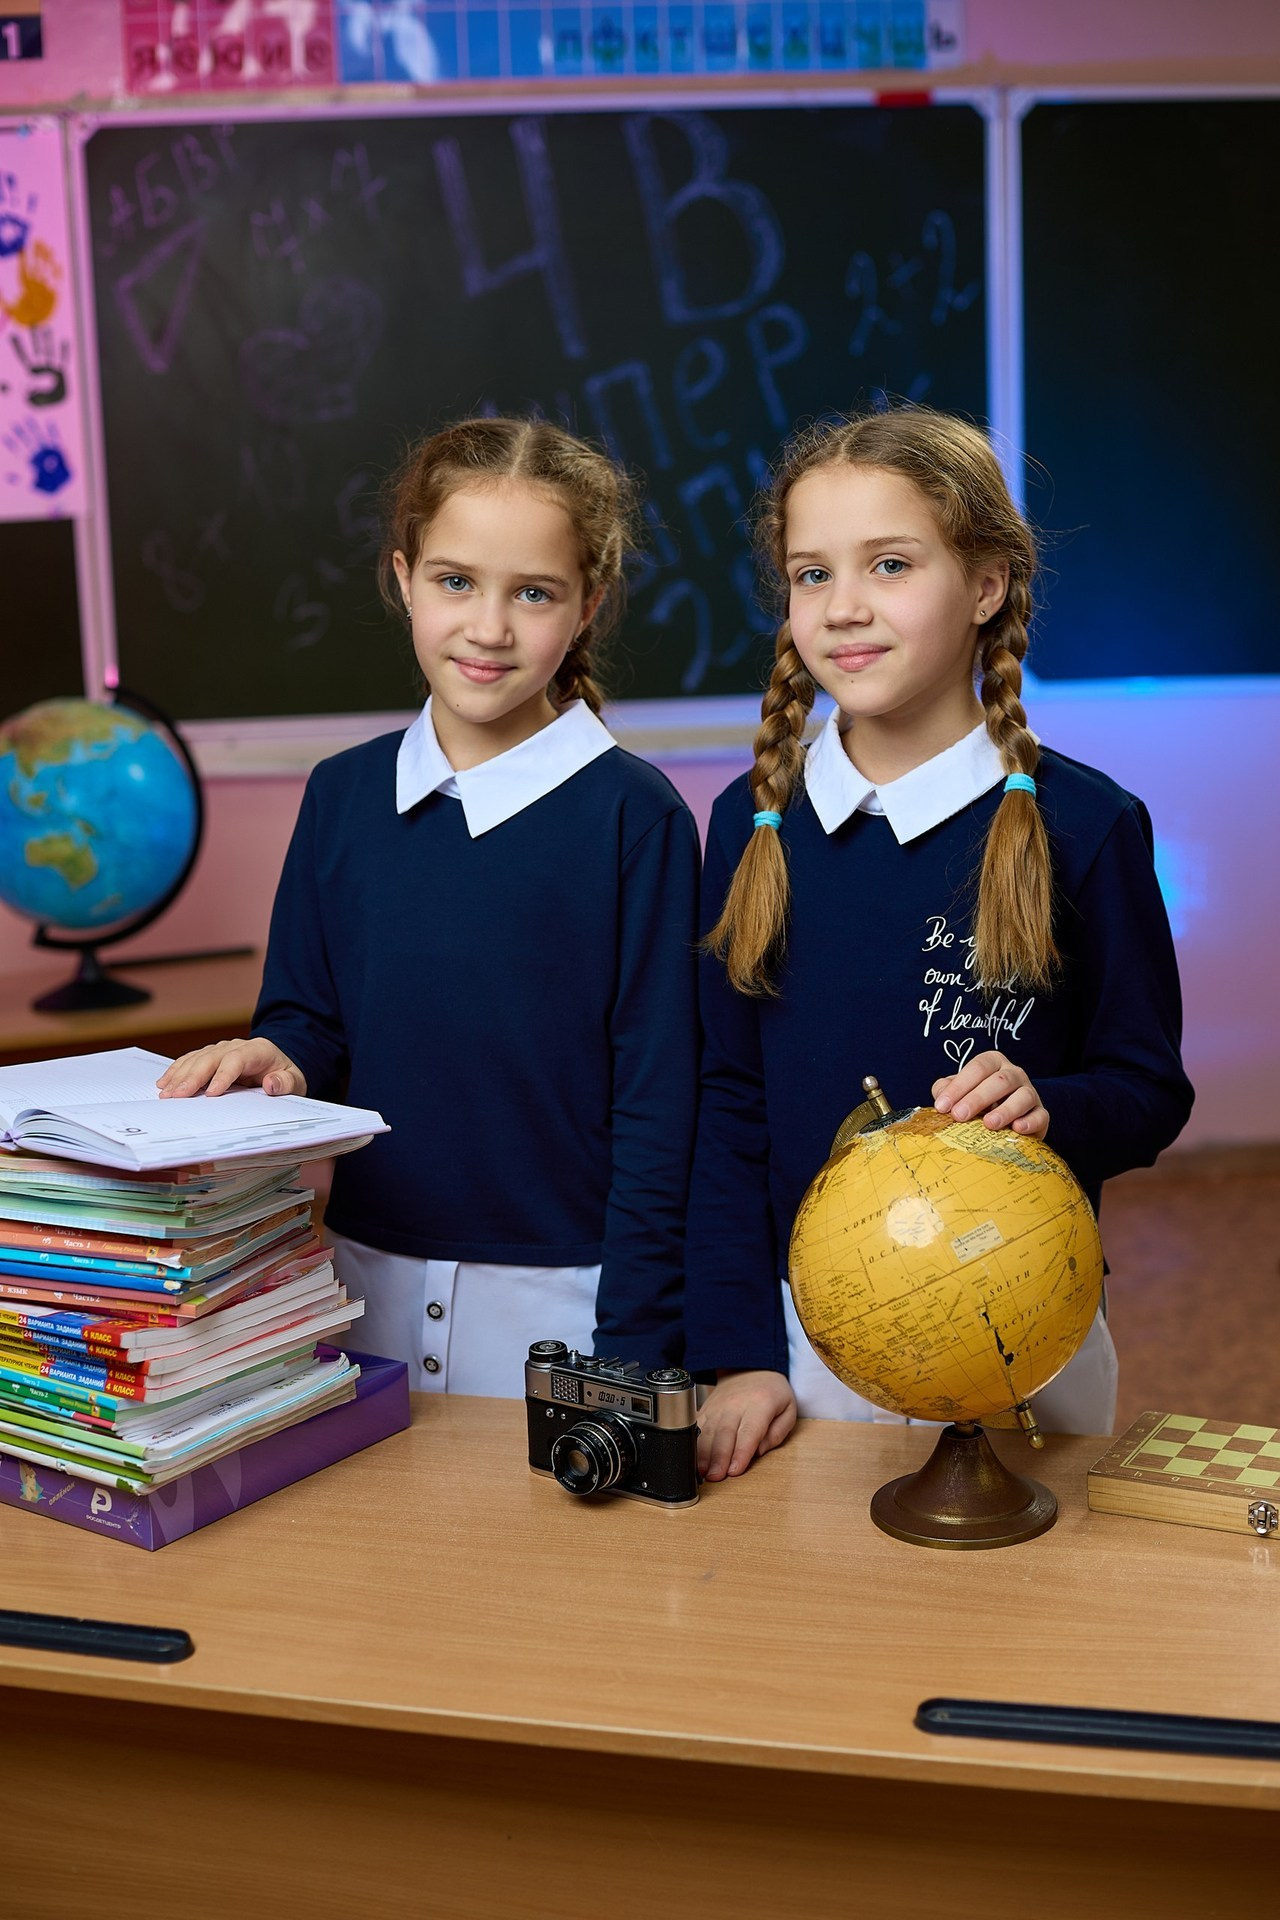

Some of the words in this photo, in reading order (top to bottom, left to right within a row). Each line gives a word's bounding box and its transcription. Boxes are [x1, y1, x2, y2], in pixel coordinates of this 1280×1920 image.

[922, 916, 955, 952] Be
[924, 968, 965, 985] own
[918, 988, 943, 1038] of
[939, 995, 1035, 1050] beautiful
[843, 1209, 883, 1234] NORTH
[63, 1239, 84, 1248] Часть
[71, 1256, 90, 1264] Часть
[989, 1270, 1031, 1297] SOUTH
[73, 1293, 94, 1302] Часть
[18, 1316, 27, 1325] 24
[28, 1318, 54, 1330] ВАРИАНТА
[56, 1324, 82, 1335] ЗАДАНИЙ
[90, 1331, 112, 1343] КЛАСС
[24, 1330, 32, 1338] 24
[33, 1332, 60, 1343] ВАРИАНТА
[61, 1338, 87, 1350] ЗАДАНИЙ
[96, 1346, 117, 1357] КЛАСС
[40, 1365, 49, 1374] 24
[49, 1368, 76, 1380] ВАРИАНТА
[78, 1375, 104, 1387] ЗАДАНИЙ
[113, 1386, 135, 1397] КЛАСС
[82, 1364, 107, 1374] ЗАДАНИЙ
[115, 1372, 136, 1383] КЛАСС
[29, 1388, 44, 1397] Часть
